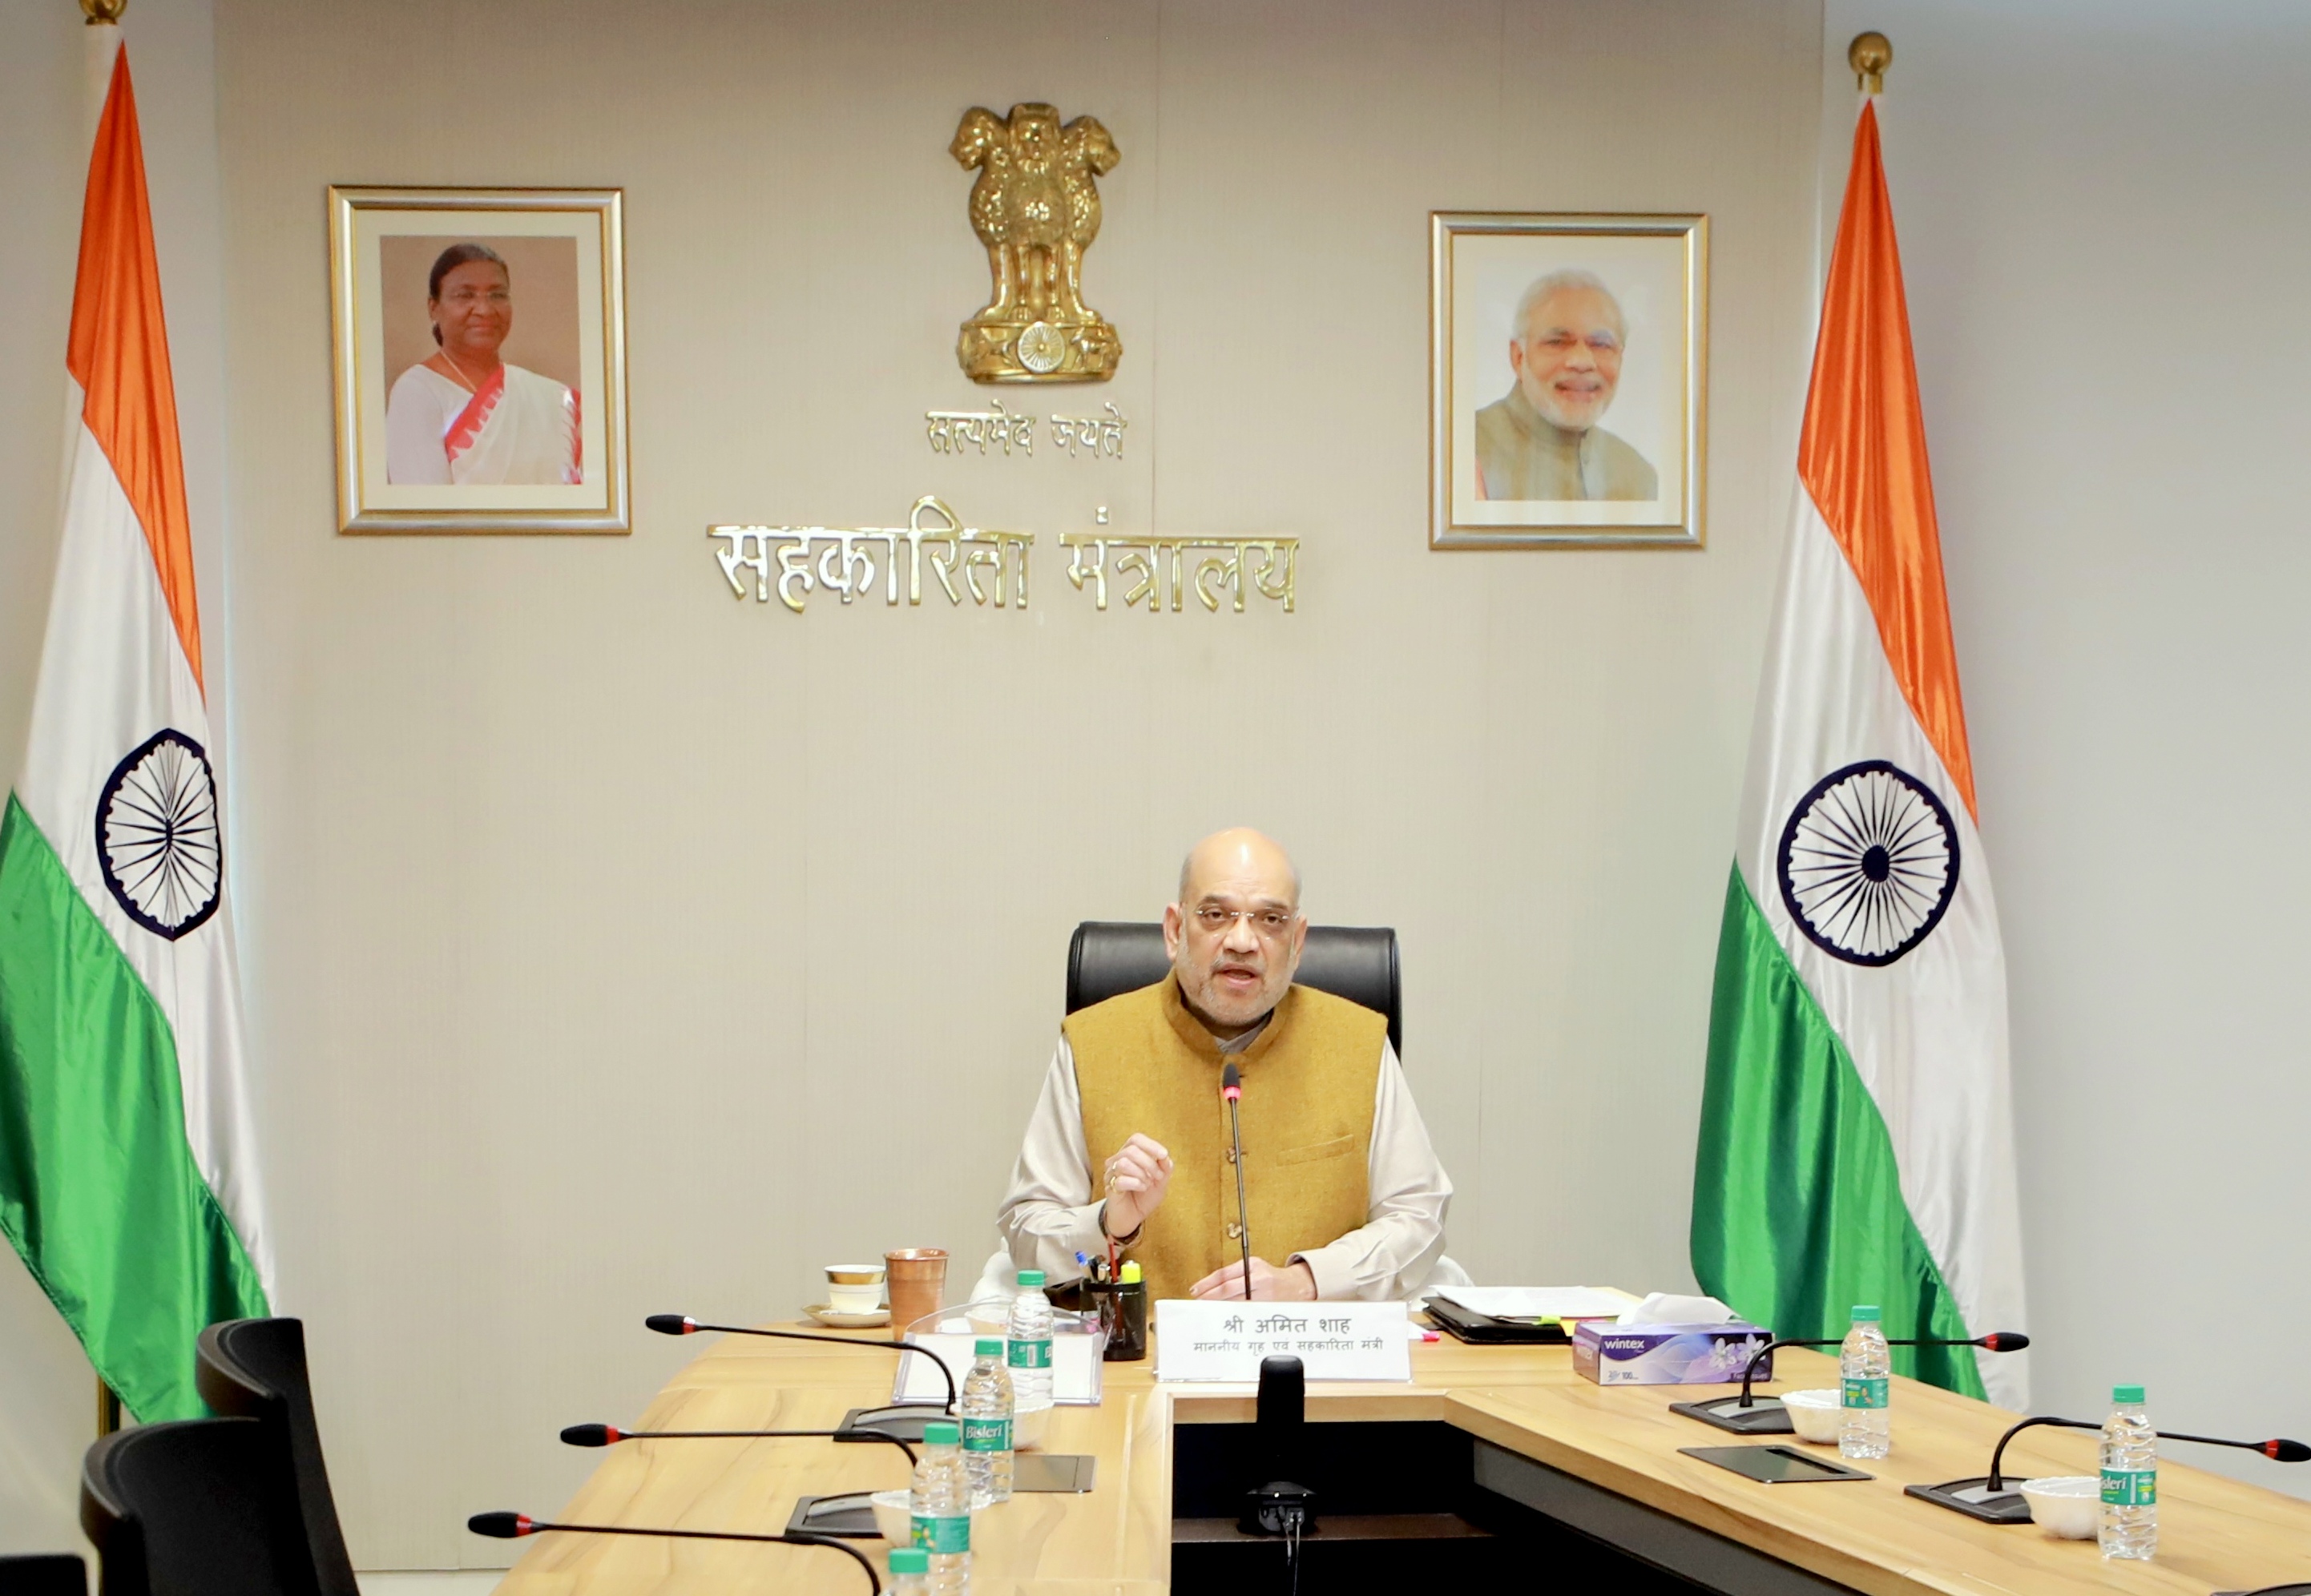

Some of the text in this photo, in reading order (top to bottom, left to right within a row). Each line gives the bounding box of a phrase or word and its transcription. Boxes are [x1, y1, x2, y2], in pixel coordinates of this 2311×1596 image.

[925, 399, 1128, 459] सत्यमेव जयते
[707, 495, 1300, 613] सहकारिता मंत्रालय
[1223, 1314, 1352, 1335] श्री अमित शाह
[1192, 1336, 1384, 1356] माननीय गृह एवं सहकारिता मंत्री
[1603, 1337, 1645, 1350] wintex
[965, 1424, 1002, 1440] Bisleri
